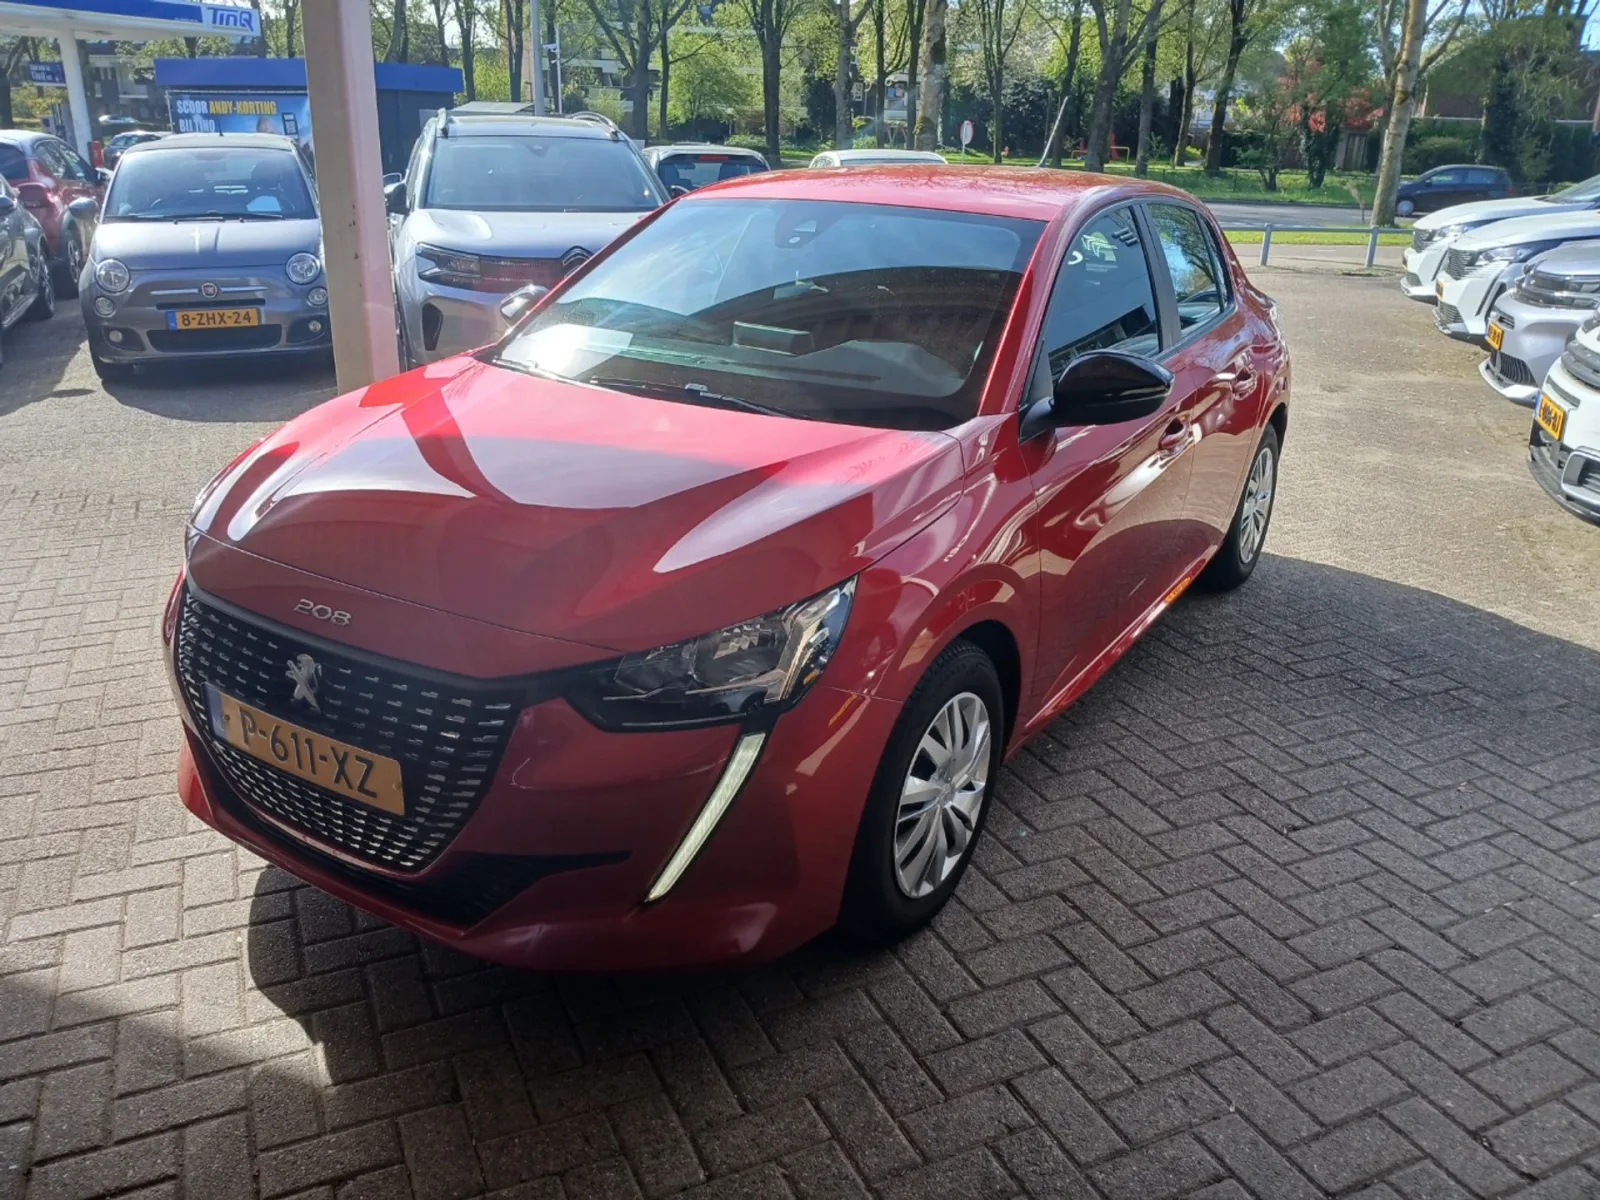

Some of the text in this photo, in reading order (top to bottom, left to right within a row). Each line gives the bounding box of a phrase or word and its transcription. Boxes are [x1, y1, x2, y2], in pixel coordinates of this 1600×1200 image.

[176, 100, 277, 115] SCOOR ANDY-KORTING
[181, 311, 252, 326] 8-ZHX-24
[294, 599, 352, 626] 208
[238, 705, 378, 799] P-611-XZ
